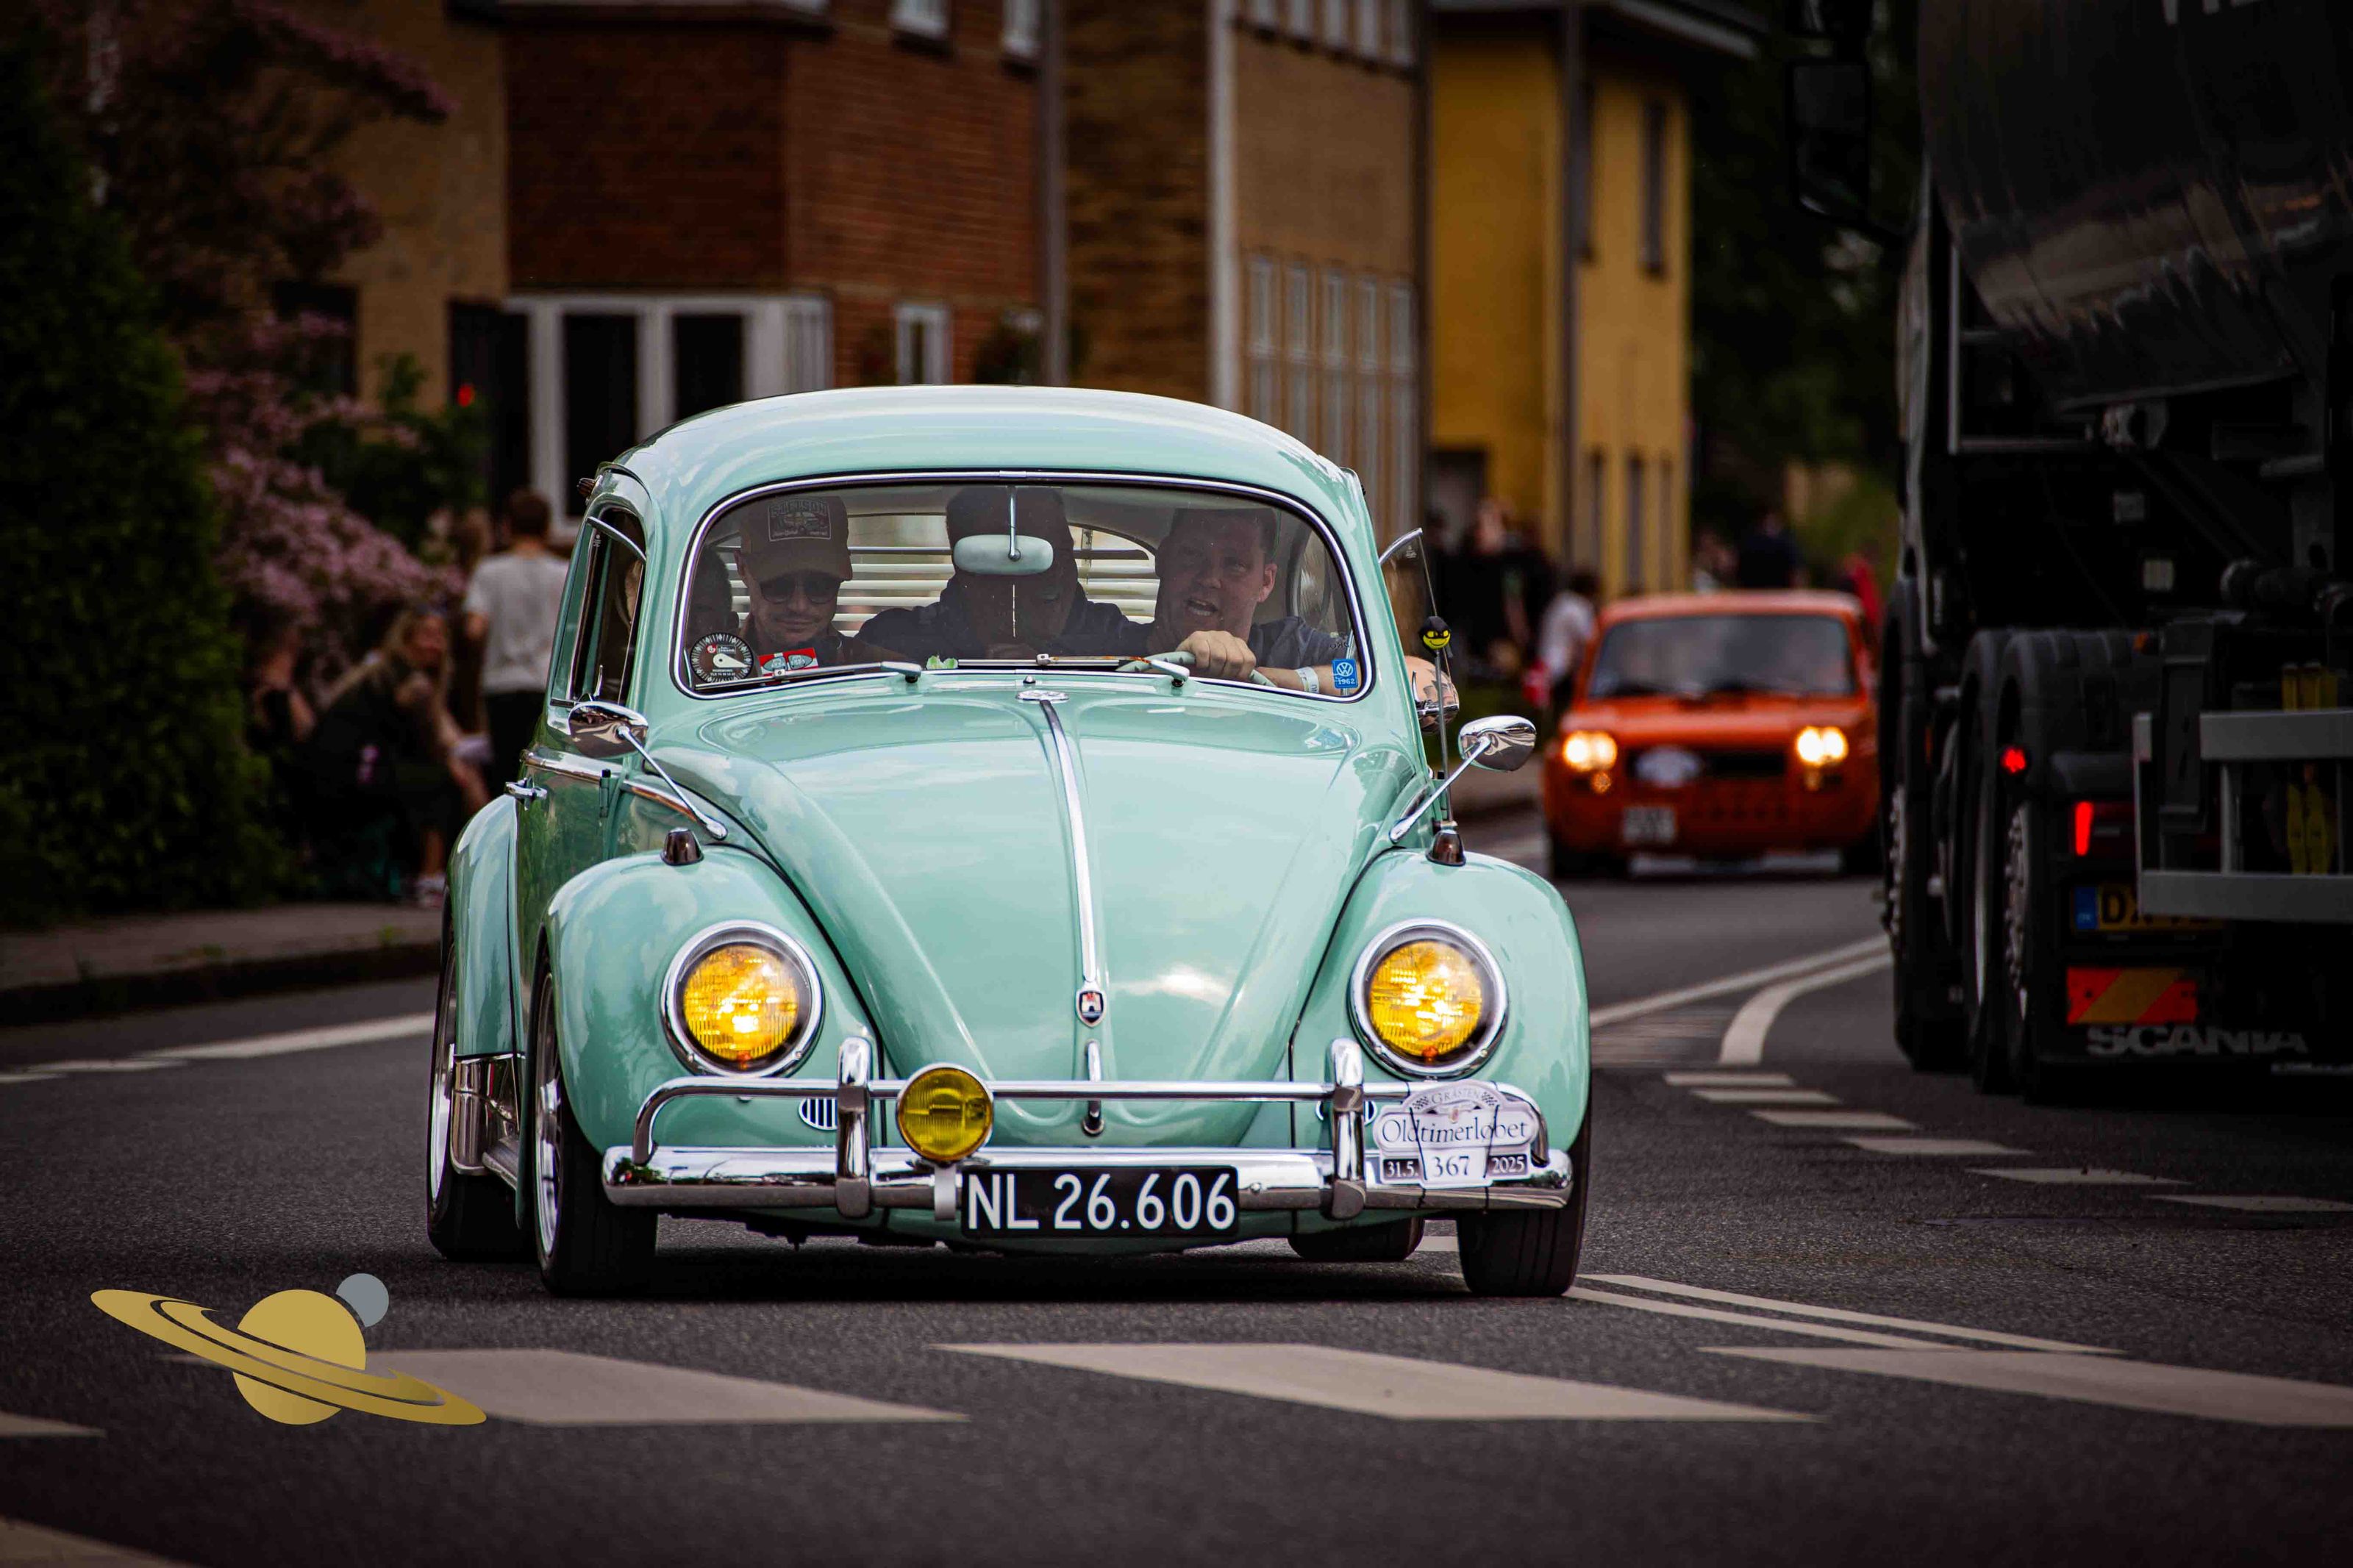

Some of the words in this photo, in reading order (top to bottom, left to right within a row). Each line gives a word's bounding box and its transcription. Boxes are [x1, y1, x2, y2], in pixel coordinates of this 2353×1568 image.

[2087, 1026, 2309, 1057] SCANIA
[1433, 1155, 1469, 1177] 367
[1491, 1156, 1525, 1173] 2025
[968, 1173, 1040, 1230] NL
[1054, 1173, 1236, 1231] 26.606
